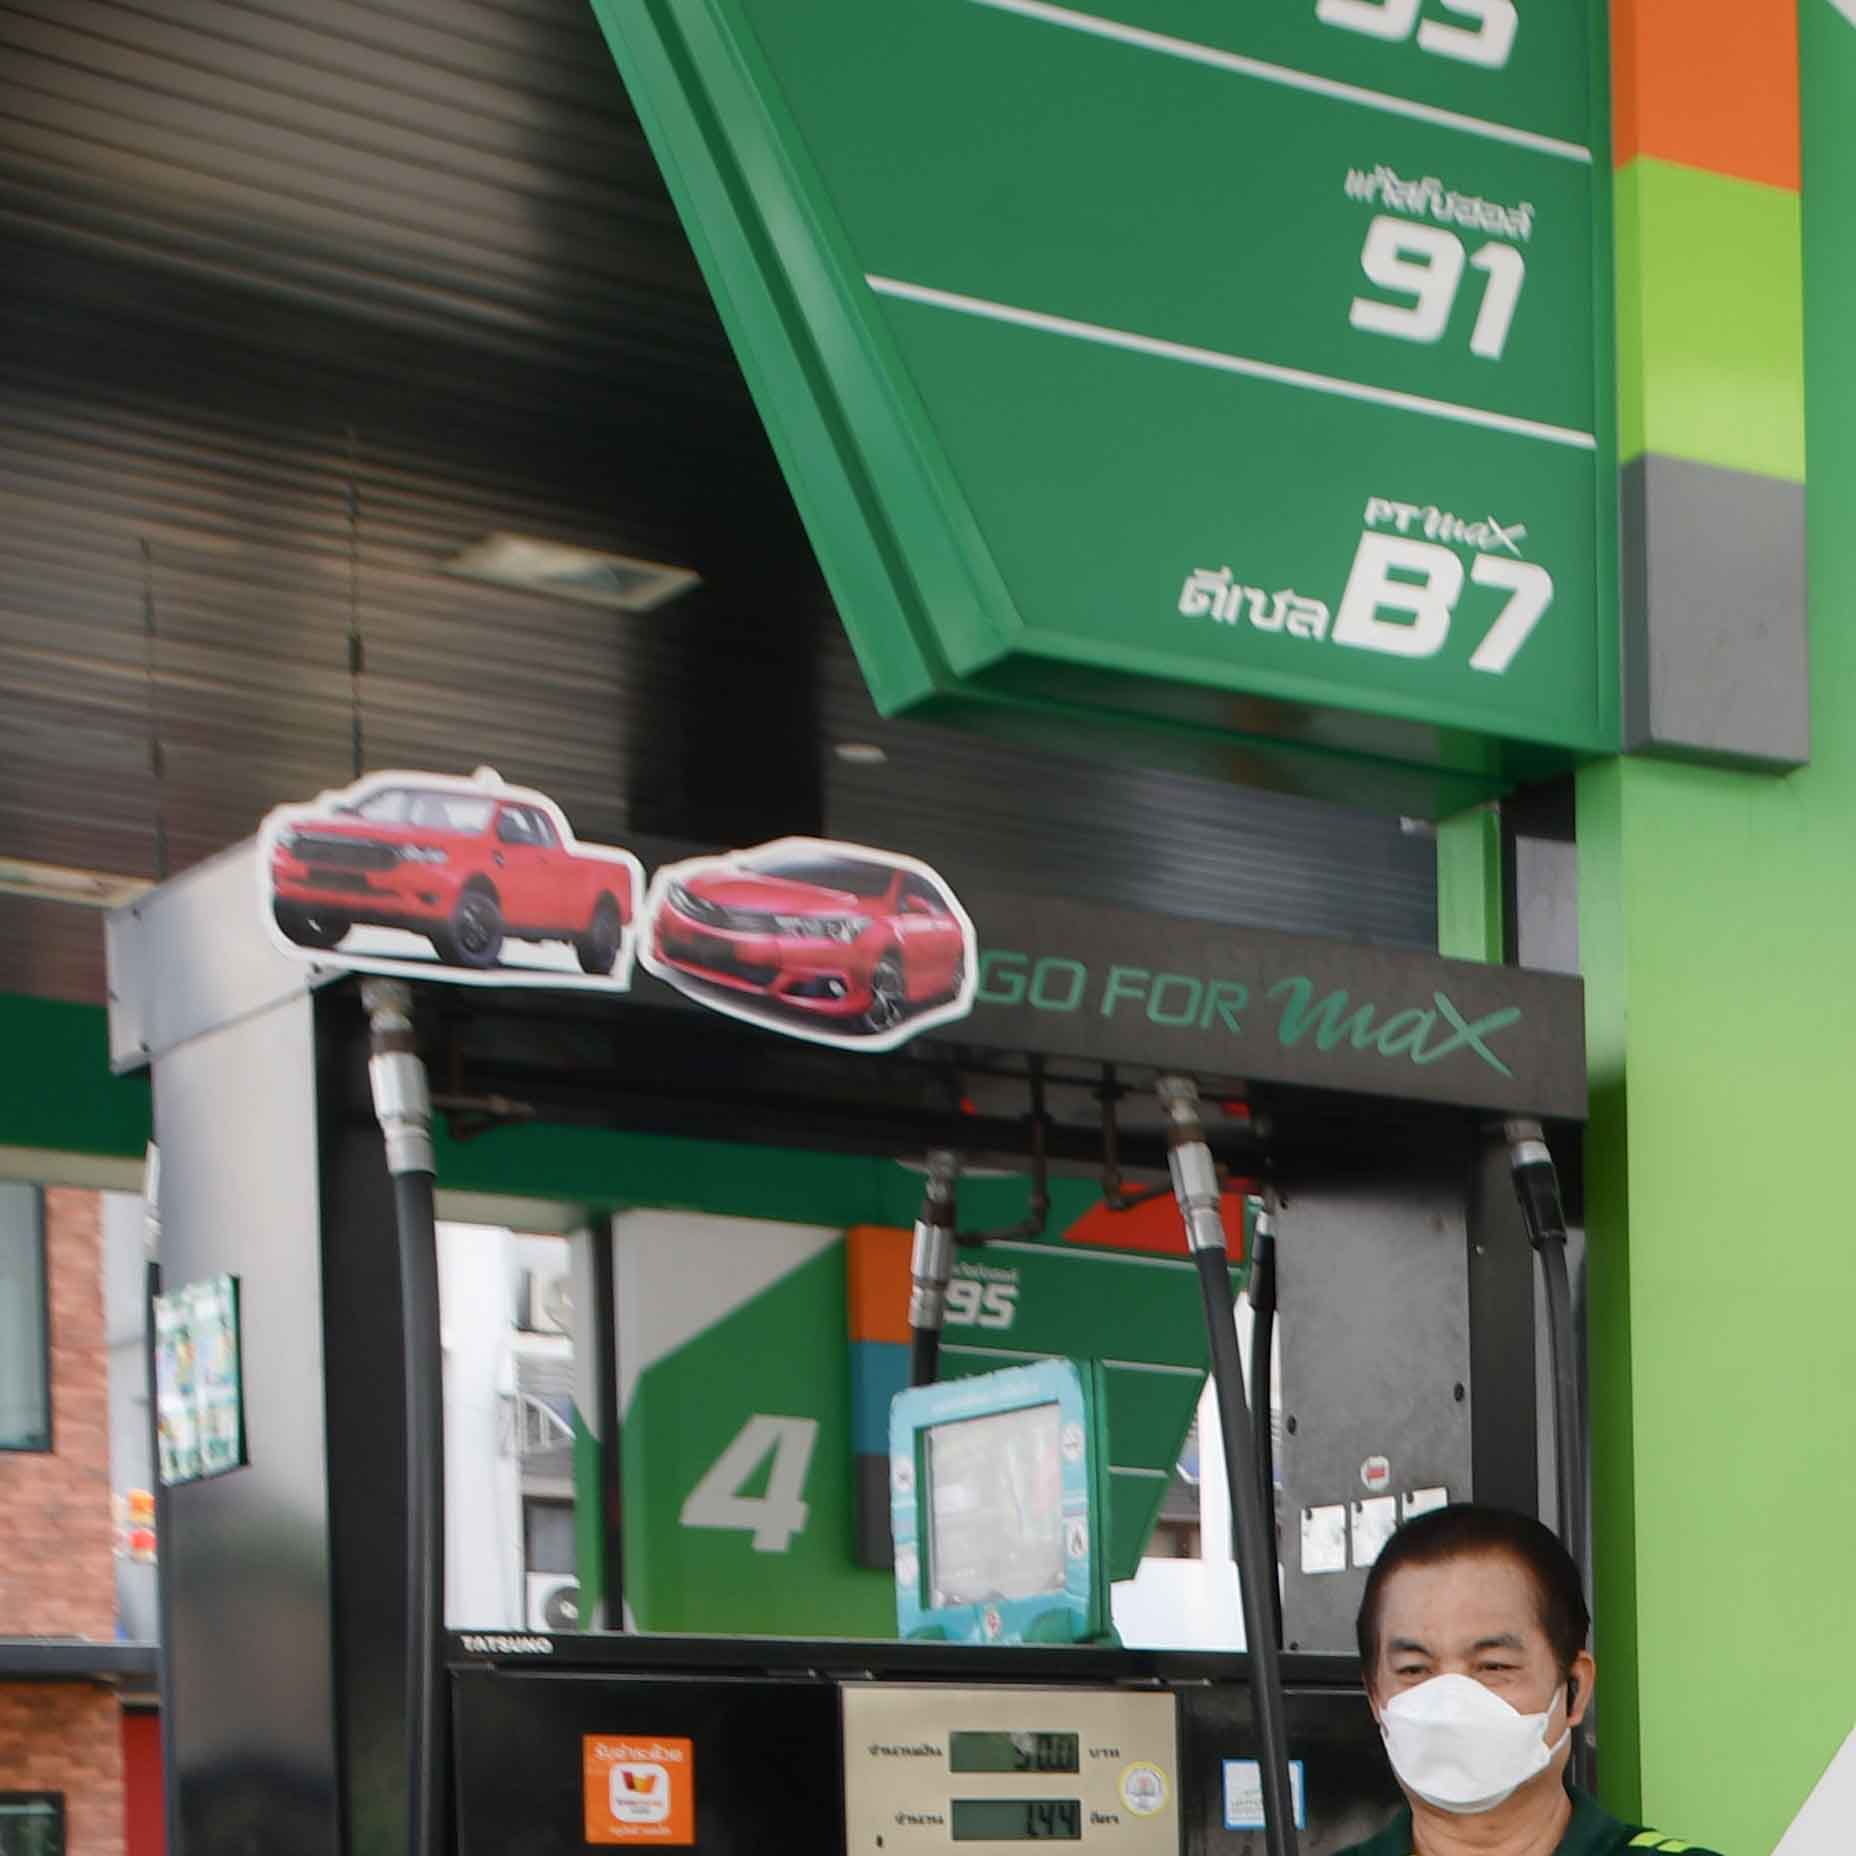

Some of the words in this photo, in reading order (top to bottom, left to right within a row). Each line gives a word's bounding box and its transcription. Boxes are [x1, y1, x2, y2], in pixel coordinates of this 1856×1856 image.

[1349, 214, 1526, 360] 91
[1364, 497, 1424, 531] PT
[1178, 566, 1330, 641] ดีเซล
[1331, 530, 1554, 676] B7
[976, 948, 1087, 1011] GO
[1100, 963, 1249, 1034] FOR
[944, 1279, 1019, 1329] 95
[681, 1412, 819, 1553] 4
[460, 1635, 554, 1654] TATSUNO
